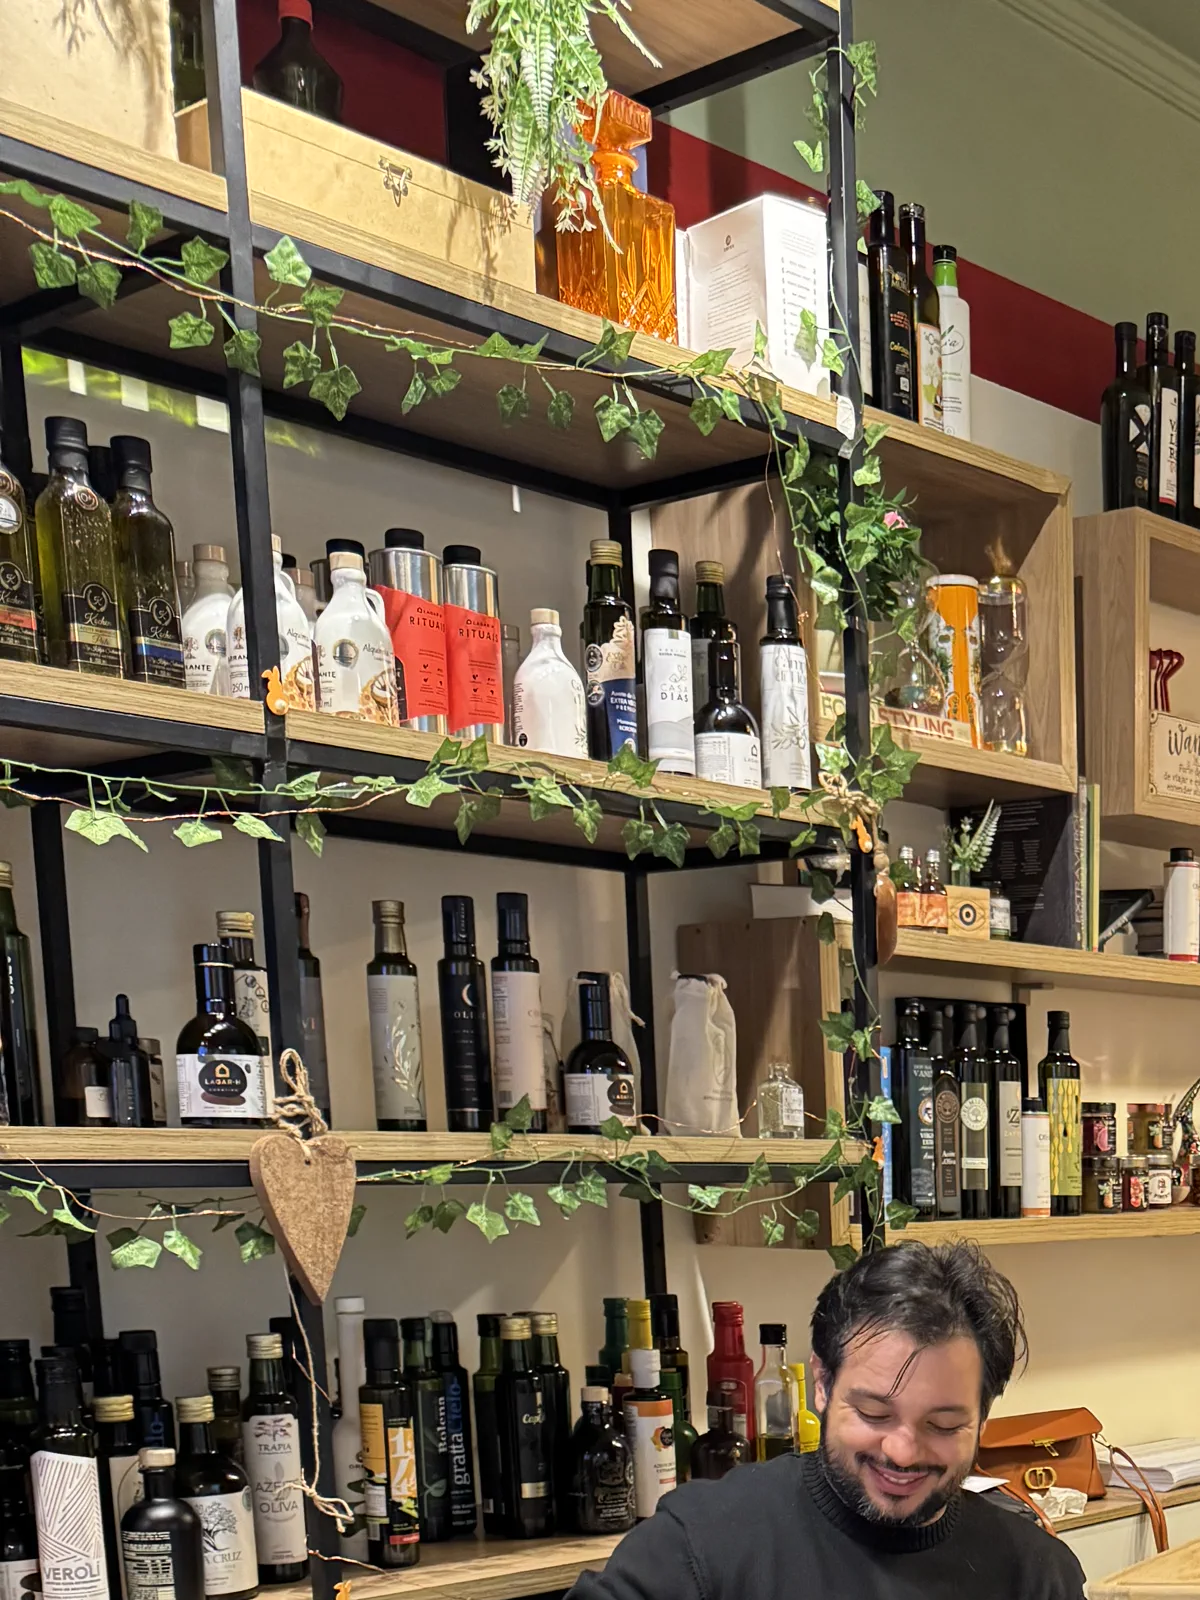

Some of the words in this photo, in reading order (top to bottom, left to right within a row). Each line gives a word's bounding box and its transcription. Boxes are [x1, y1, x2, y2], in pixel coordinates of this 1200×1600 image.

[459, 628, 499, 643] RITUAIS
[660, 692, 689, 703] DIAS
[877, 706, 955, 738] STYLING
[259, 1500, 299, 1514] OLIVA
